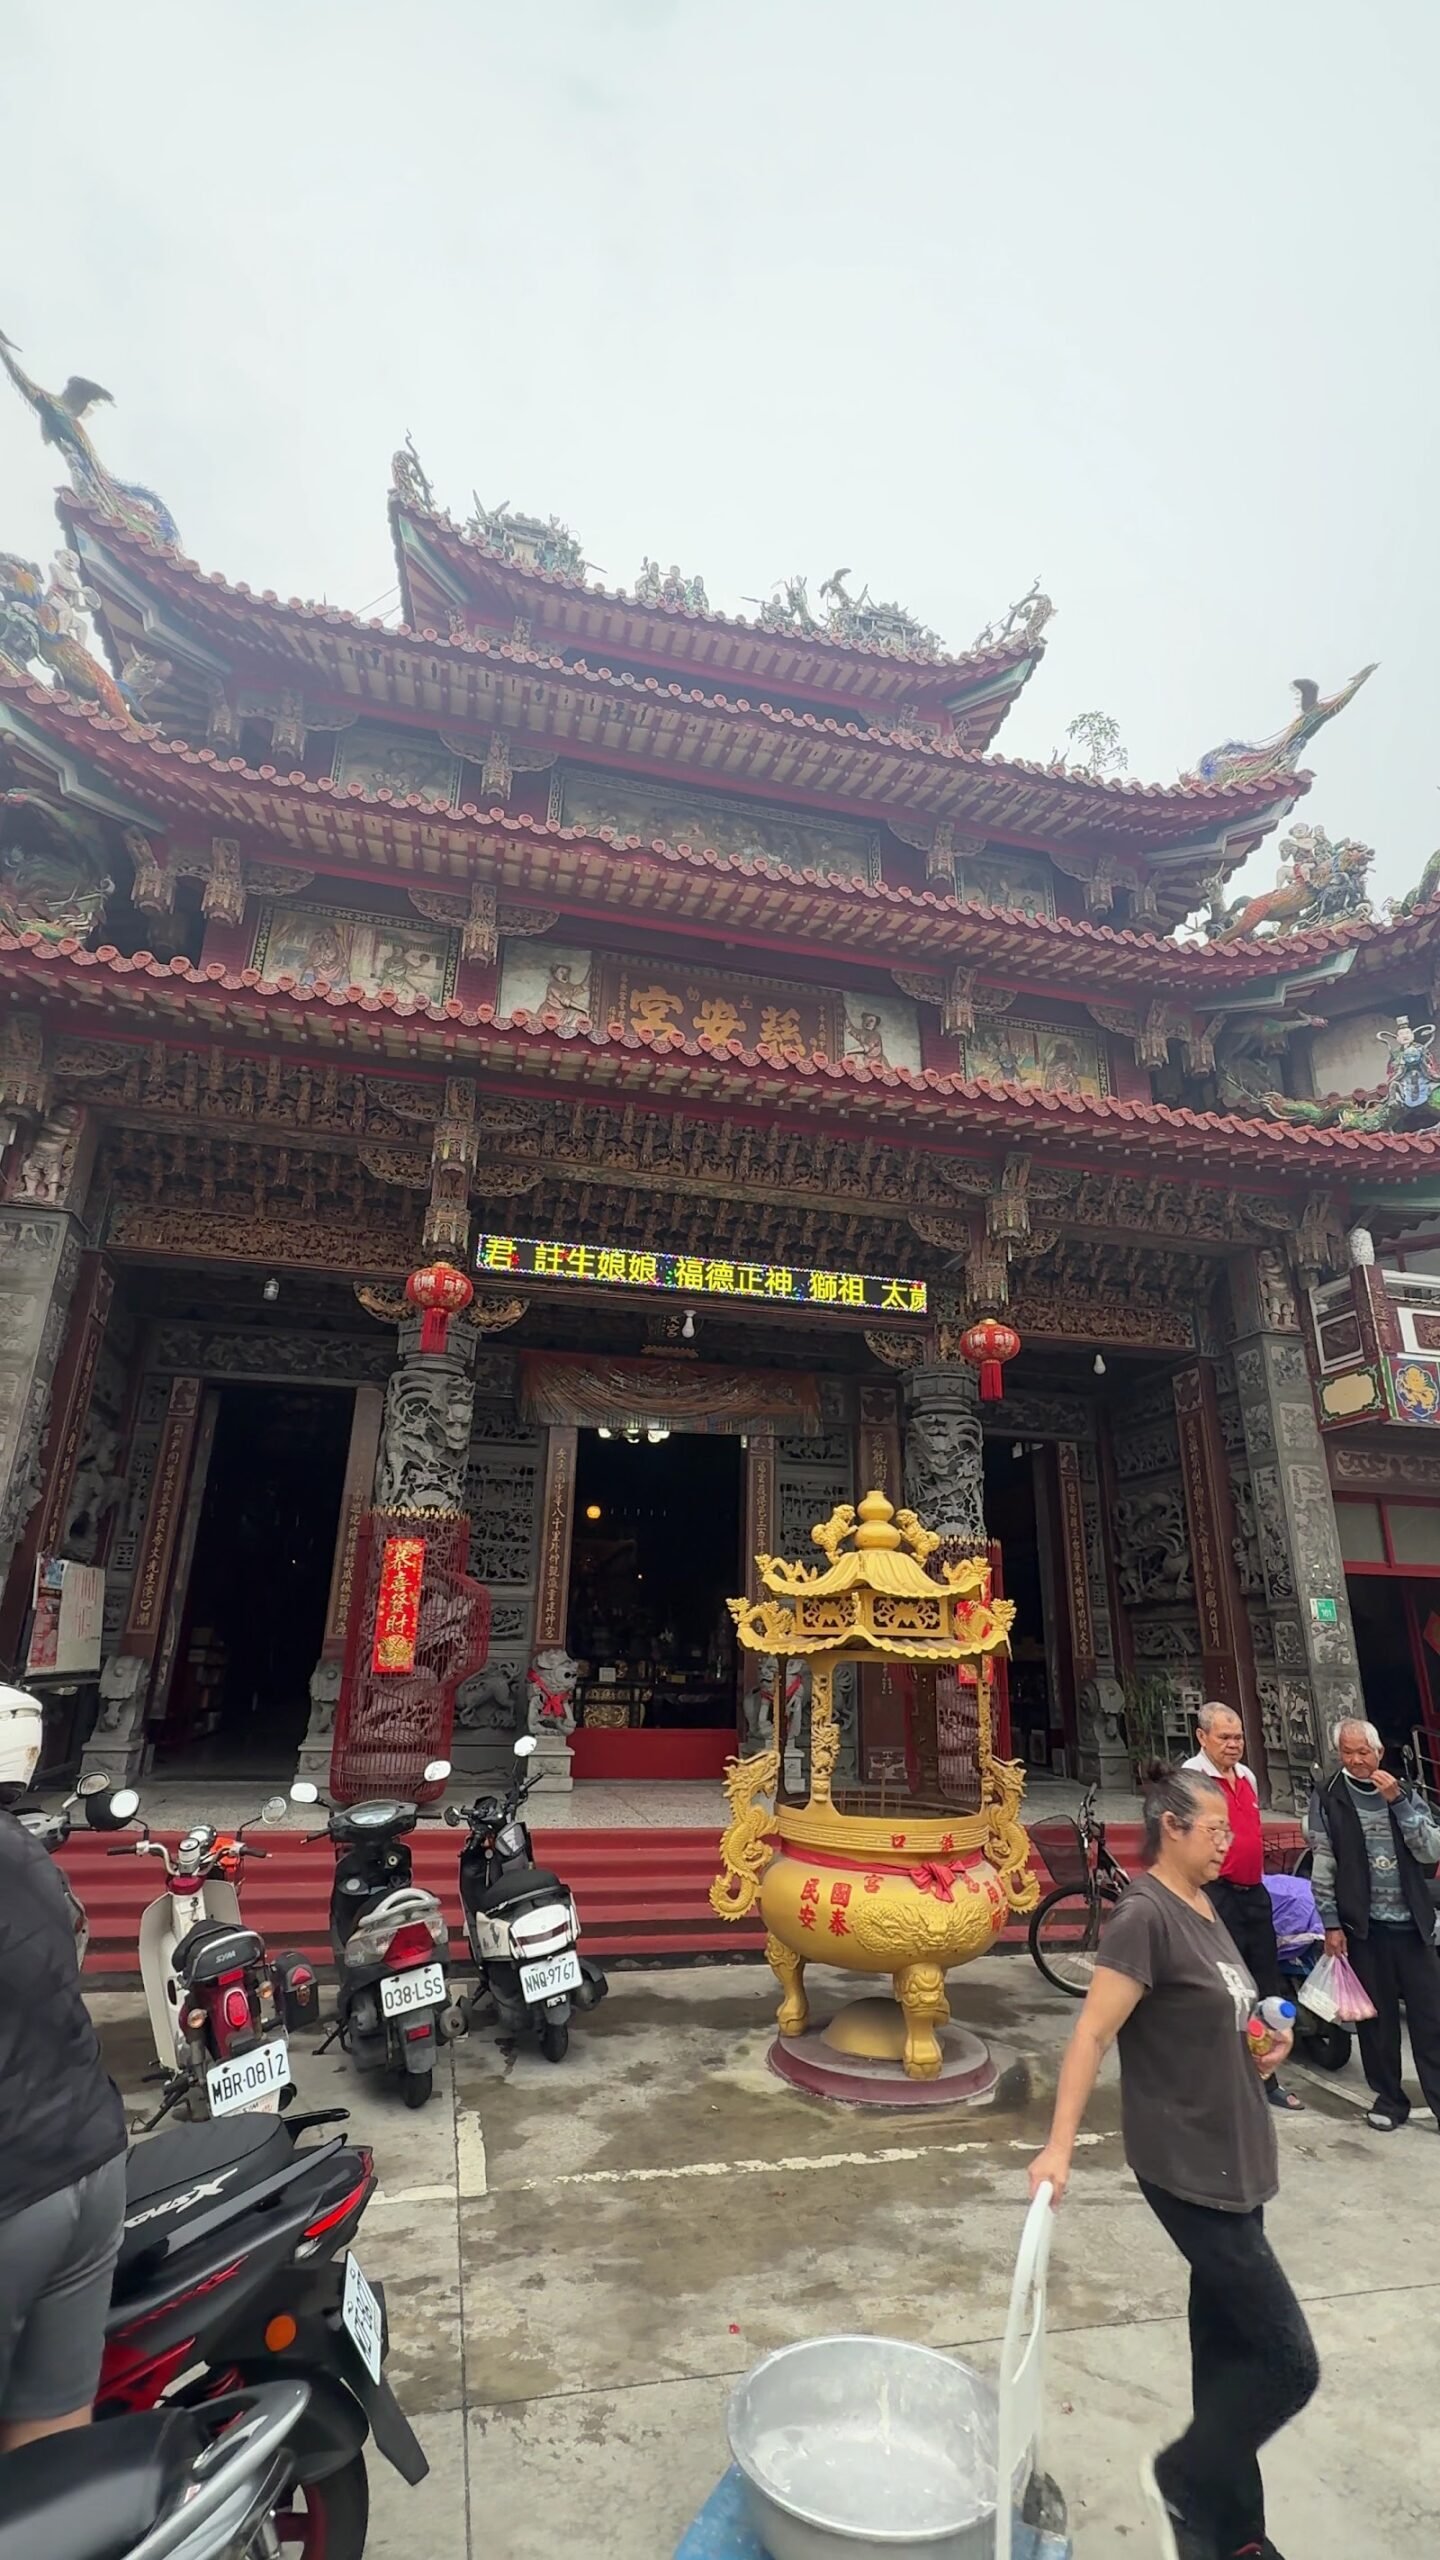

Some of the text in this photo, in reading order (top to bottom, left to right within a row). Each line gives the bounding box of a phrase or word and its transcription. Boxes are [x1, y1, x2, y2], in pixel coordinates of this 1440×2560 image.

[484, 1237, 518, 1271] 君
[534, 1243, 658, 1284] 註生娘娘
[675, 1255, 794, 1296] 福德正神
[808, 1271, 867, 1305] 獅祖
[384, 1550, 414, 1633] 恭喜發財
[797, 1877, 821, 1933] 民安
[828, 1881, 855, 1937] 國泰
